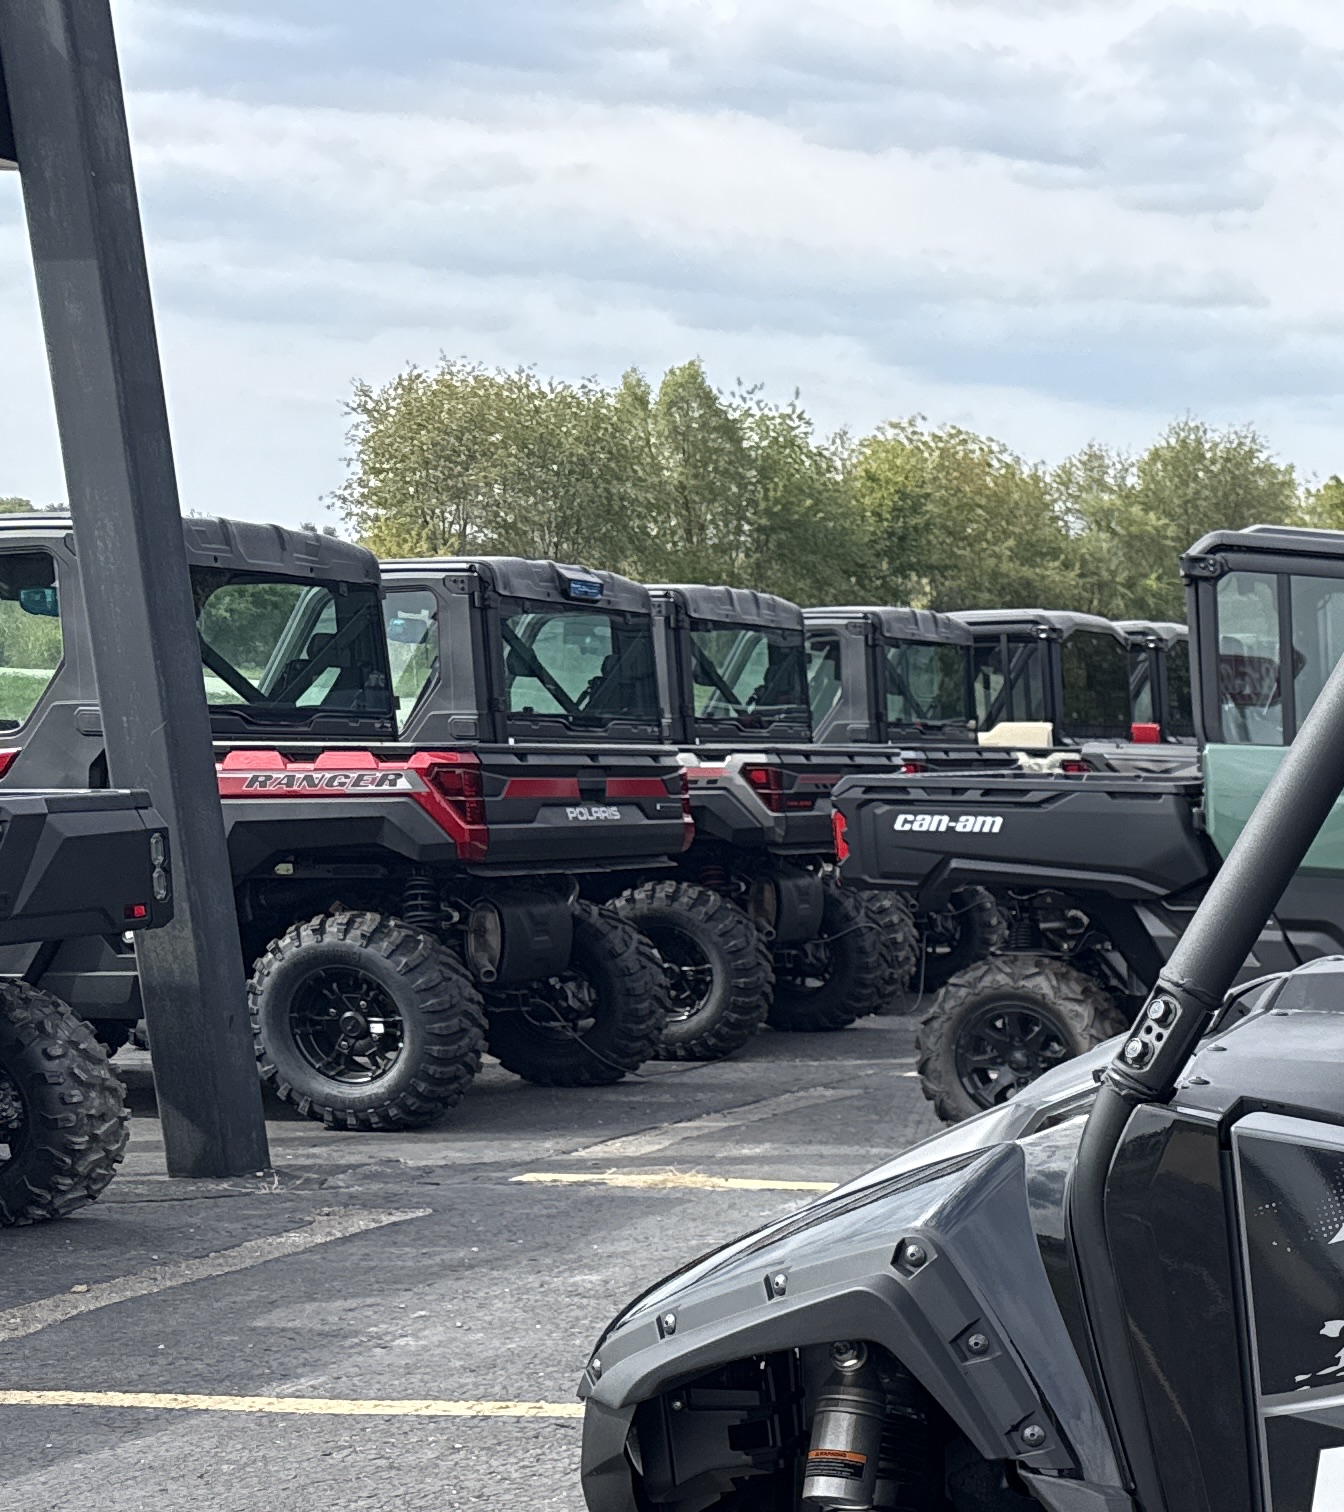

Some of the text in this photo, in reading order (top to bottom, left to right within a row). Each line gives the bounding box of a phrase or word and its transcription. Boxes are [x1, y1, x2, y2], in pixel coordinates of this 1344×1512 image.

[243, 772, 404, 790] RANGER
[566, 806, 621, 821] POLARIS
[893, 814, 1004, 833] can-am
